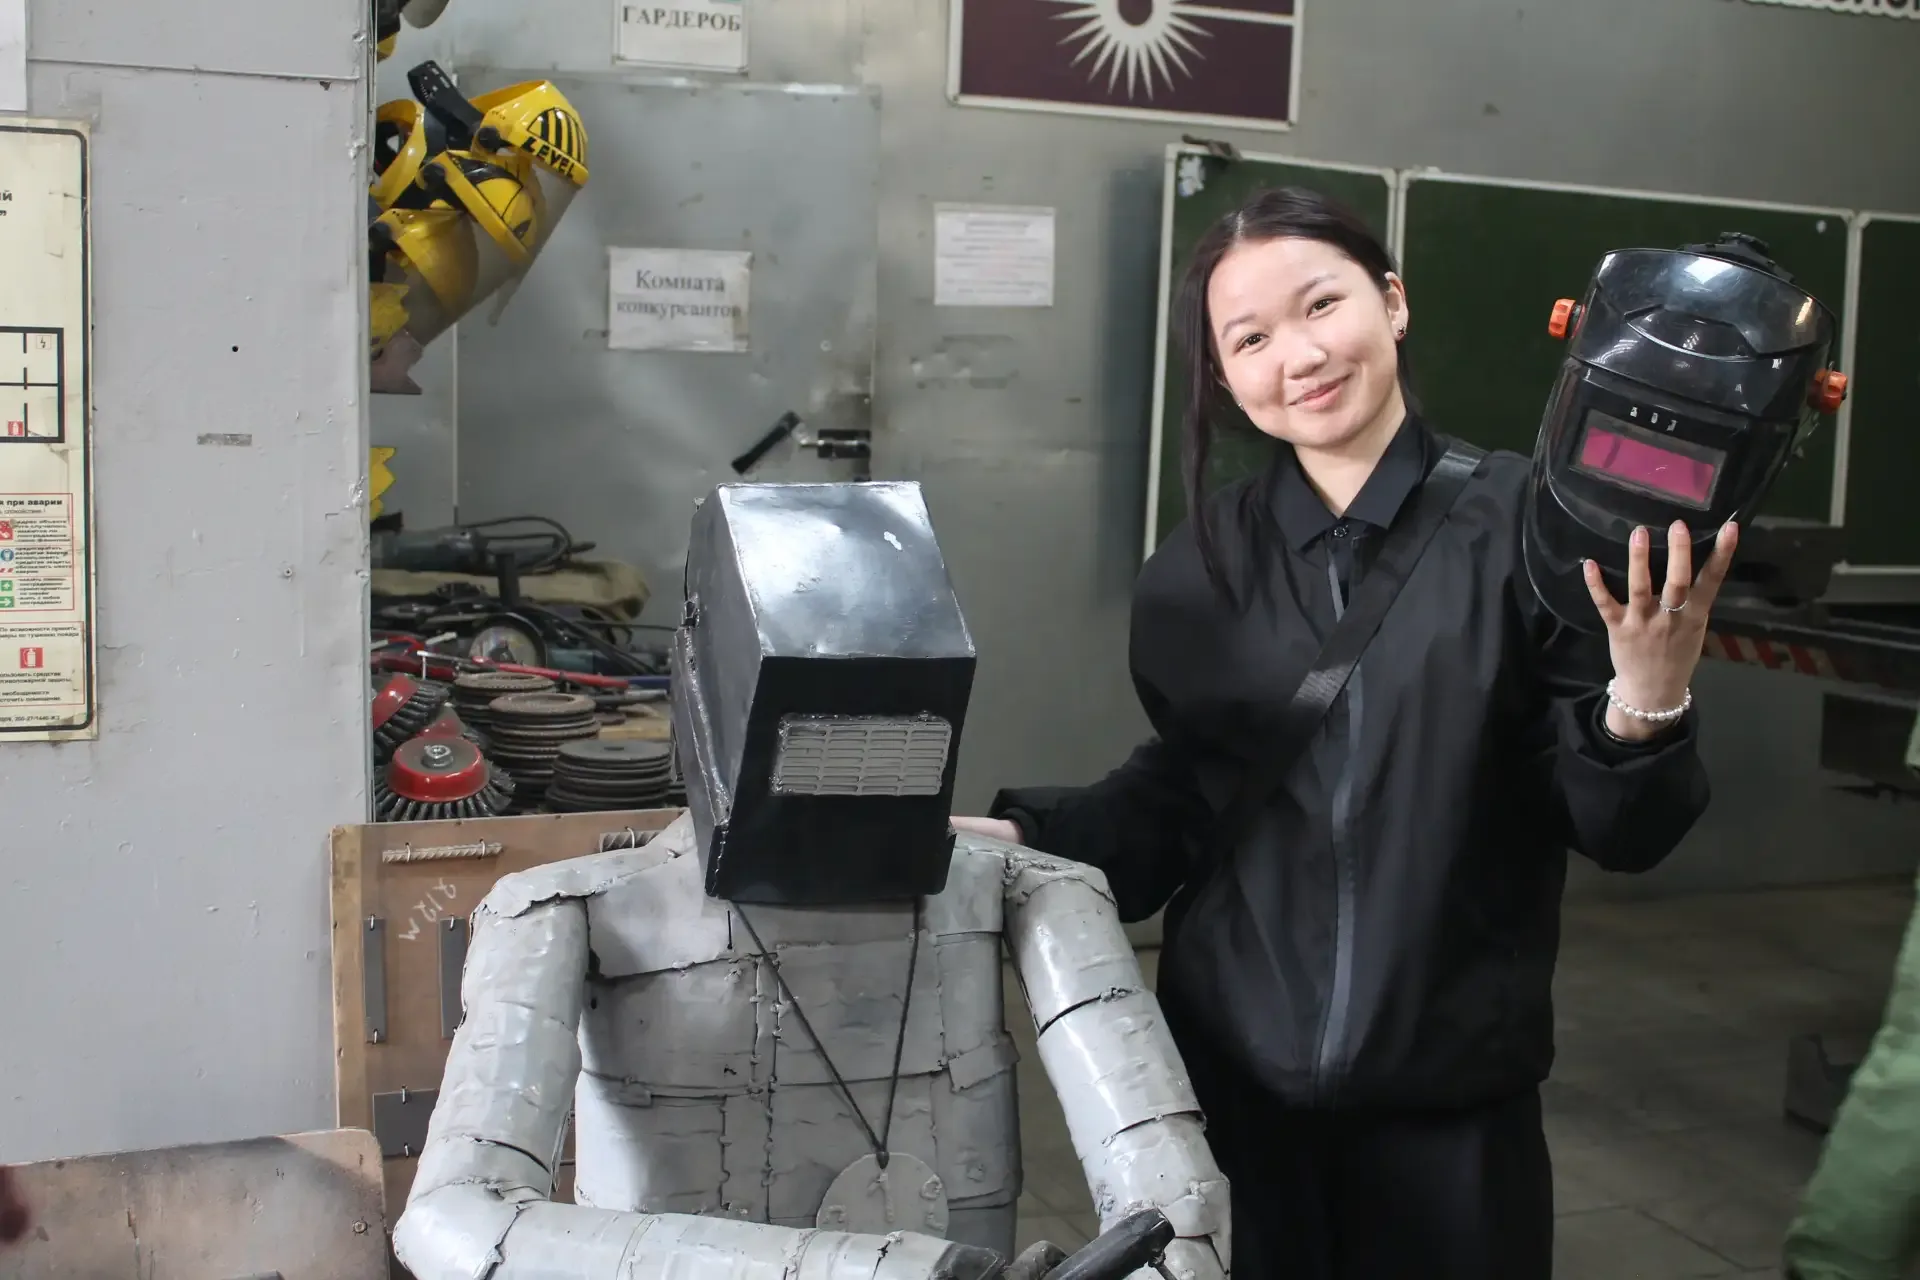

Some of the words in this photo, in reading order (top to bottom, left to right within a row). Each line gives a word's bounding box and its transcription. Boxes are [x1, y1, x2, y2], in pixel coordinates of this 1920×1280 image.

[623, 6, 741, 31] ГАРДЕРОБ
[521, 136, 574, 178] LEVEL
[636, 269, 726, 292] Комната
[616, 301, 742, 320] конкурсантов
